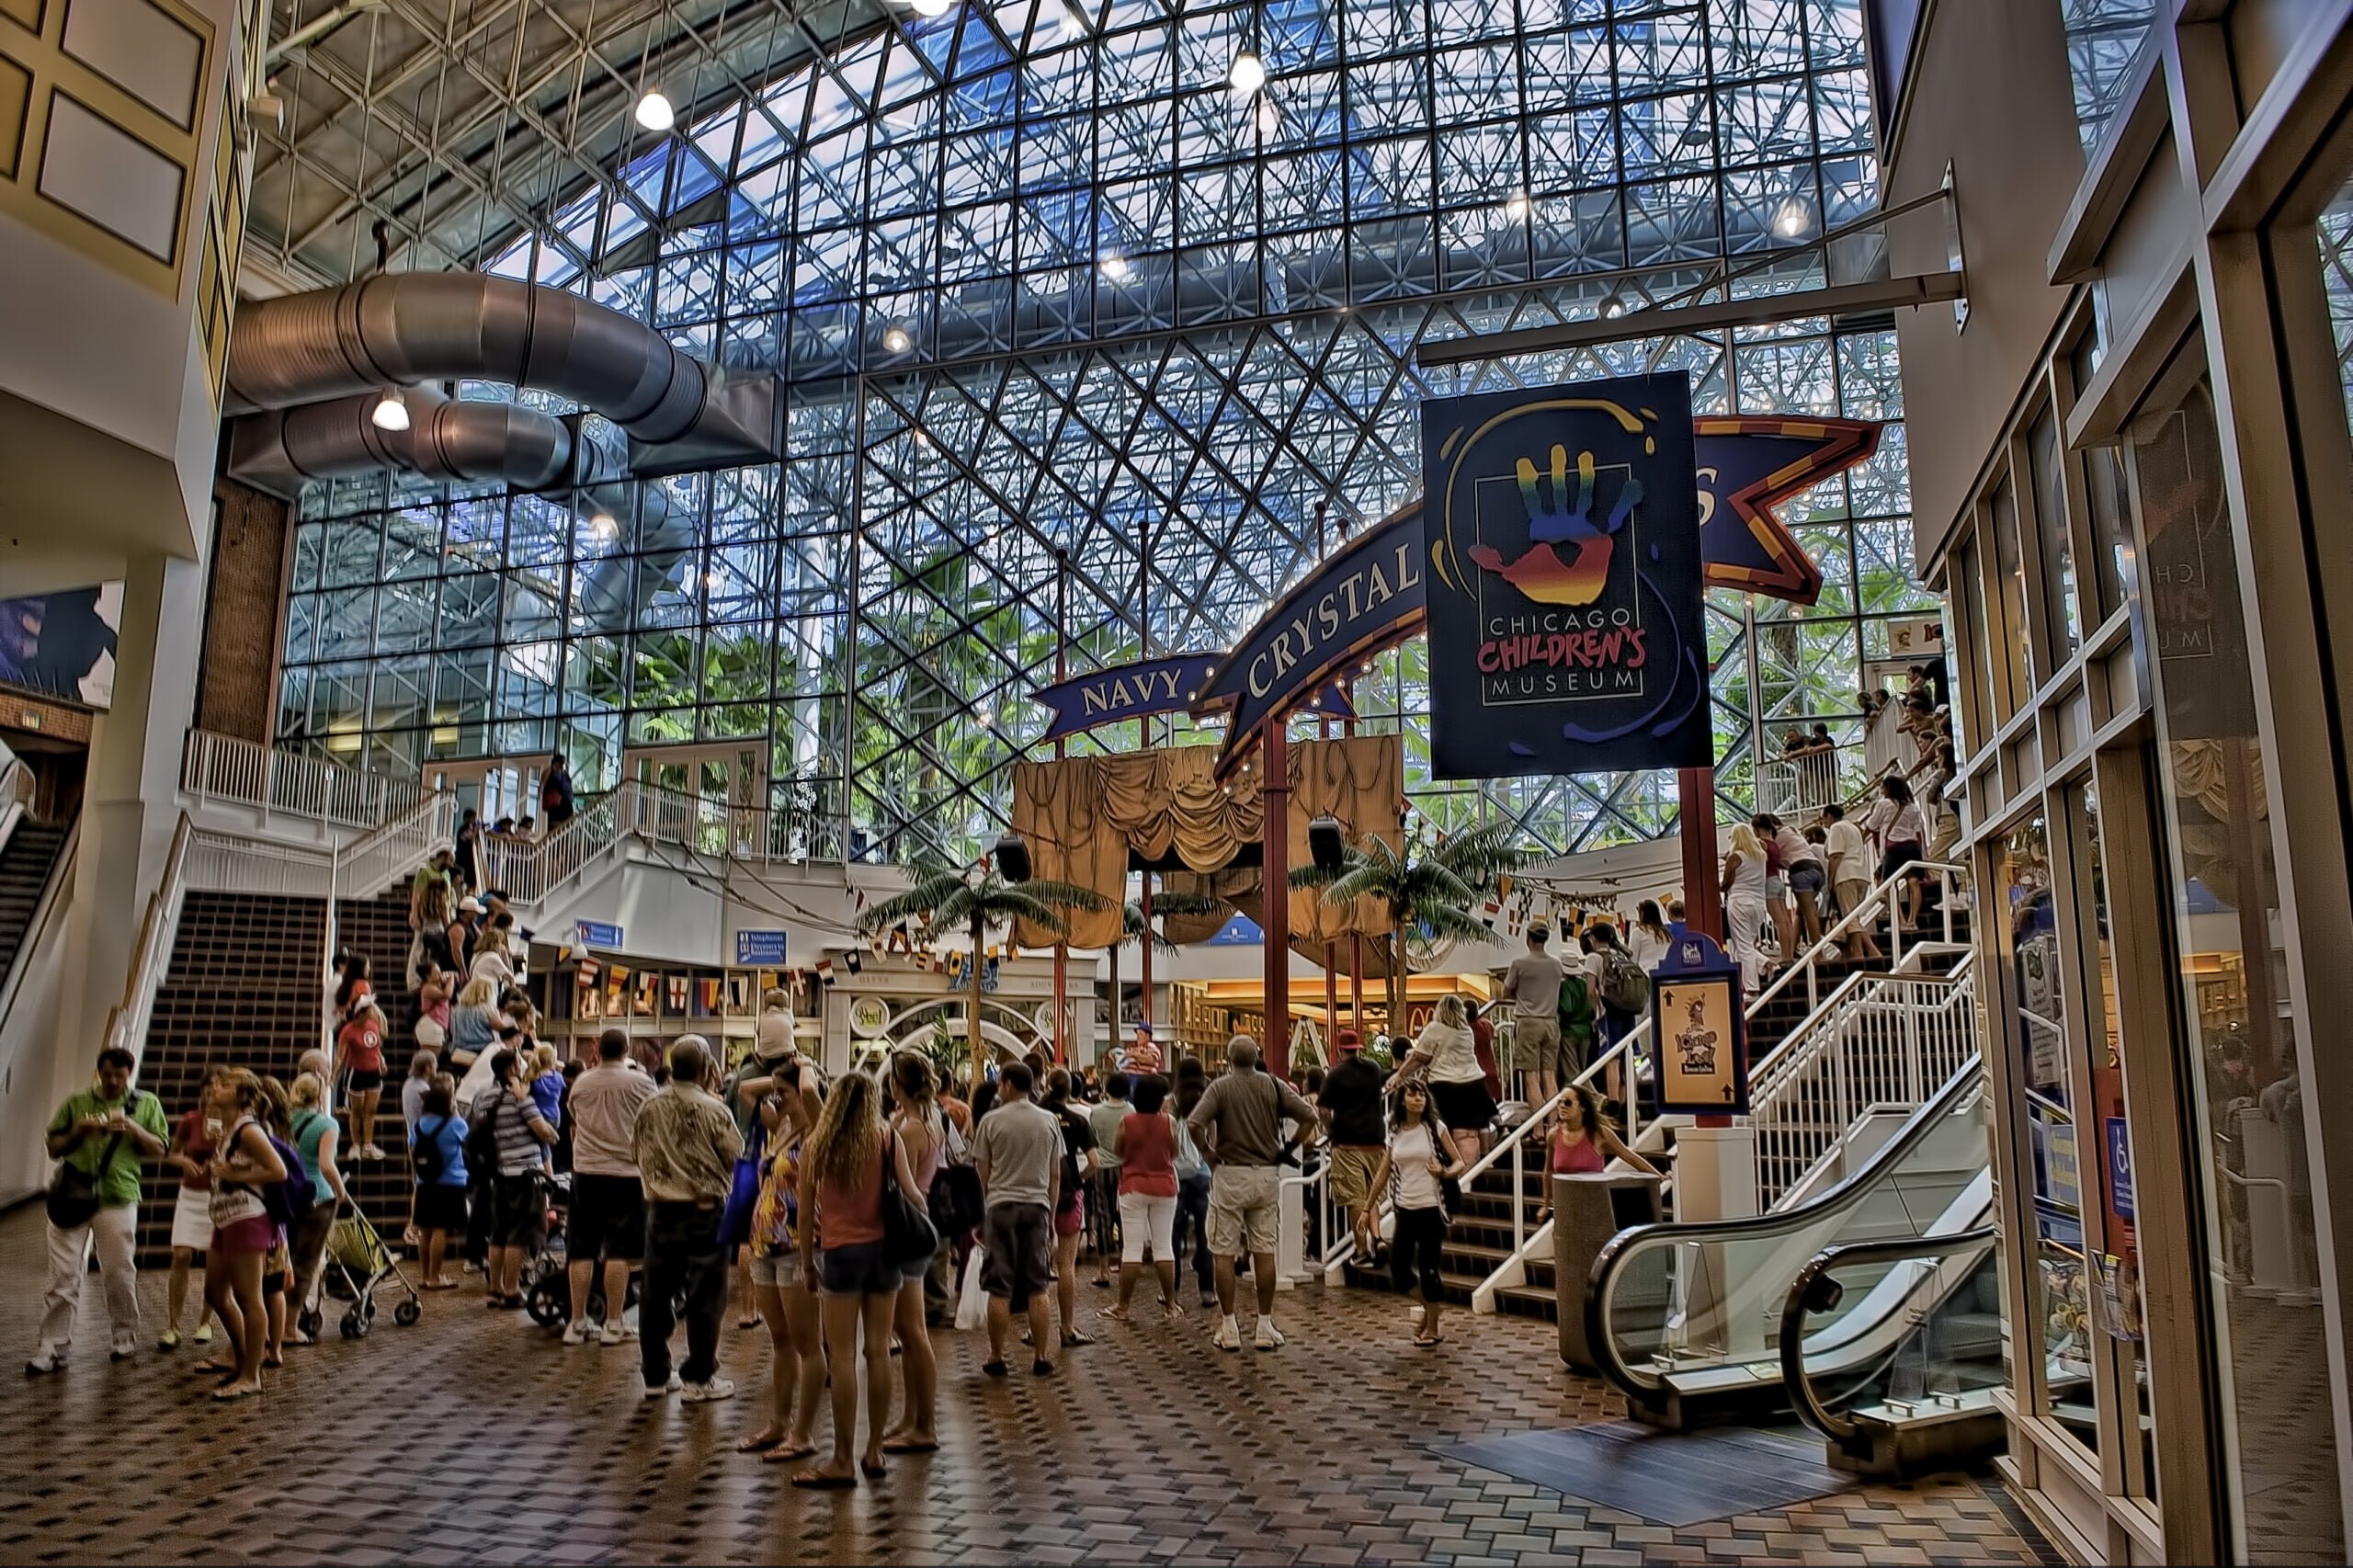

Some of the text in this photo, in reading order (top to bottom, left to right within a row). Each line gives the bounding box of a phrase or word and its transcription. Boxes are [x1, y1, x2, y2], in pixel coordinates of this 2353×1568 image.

[1248, 543, 1420, 699] CRYSTAL
[1489, 608, 1631, 635] CHICAGO
[1477, 626, 1646, 673] CHILDREN'S
[1081, 668, 1182, 716] NAVY
[1492, 671, 1634, 697] MUSEUM
